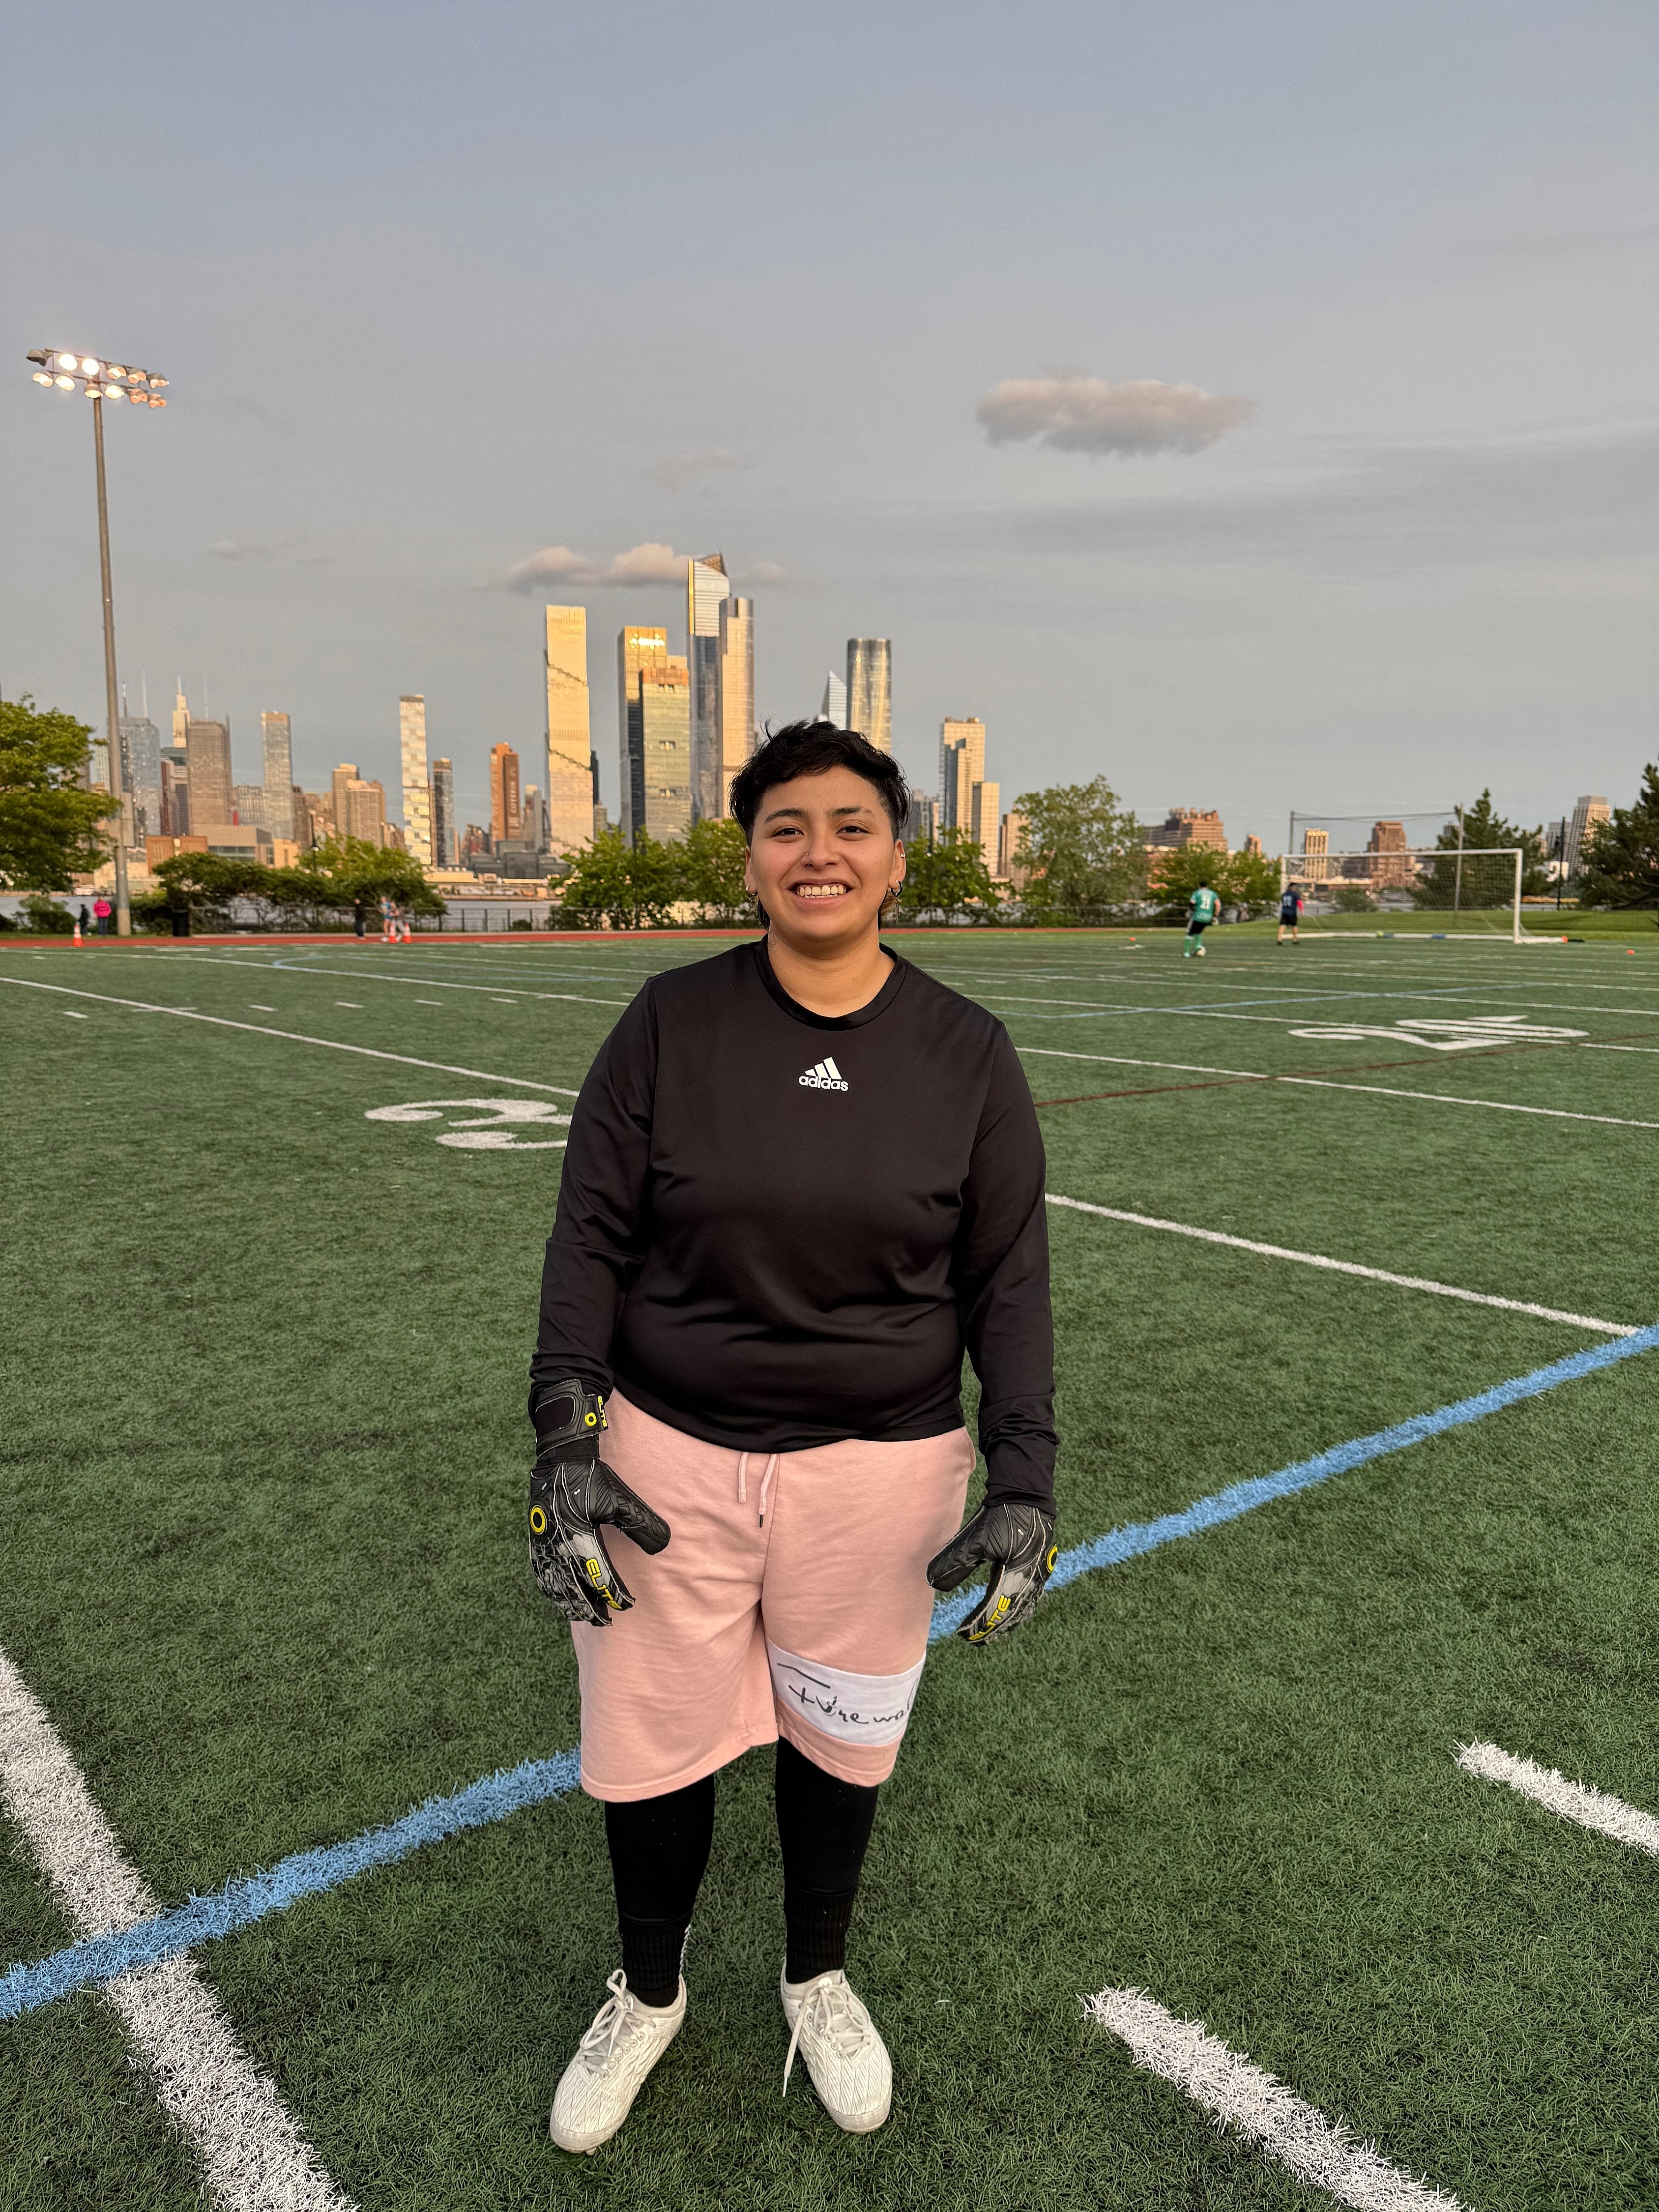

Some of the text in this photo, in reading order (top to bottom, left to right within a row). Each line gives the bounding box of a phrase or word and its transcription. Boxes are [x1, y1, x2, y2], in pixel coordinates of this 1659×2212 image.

[798, 1076, 849, 1092] adidas
[597, 1396, 608, 1427] ELITE
[585, 1558, 622, 1609] ELITE
[968, 1595, 1011, 1640] ELITE
